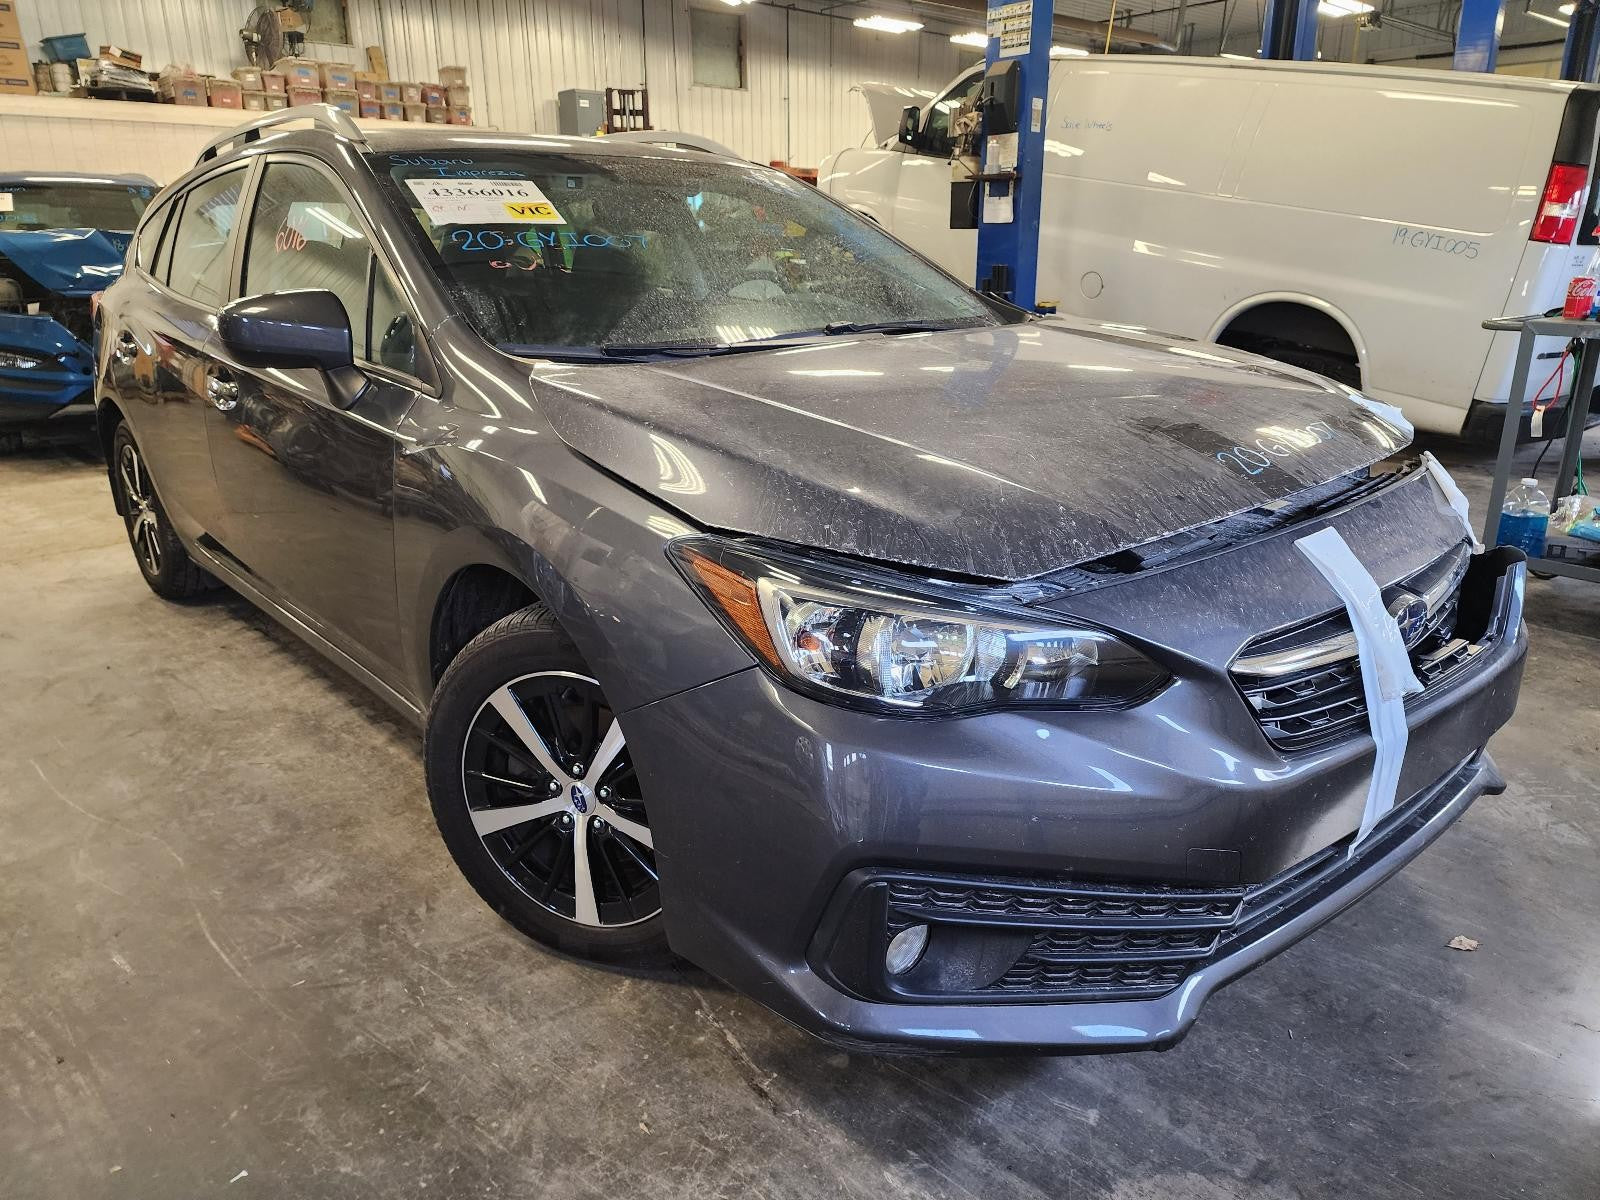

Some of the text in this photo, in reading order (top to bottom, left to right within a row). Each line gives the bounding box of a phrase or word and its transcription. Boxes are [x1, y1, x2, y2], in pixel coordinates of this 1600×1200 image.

[389, 154, 474, 167] Subaru
[429, 167, 526, 179] Impreza
[428, 187, 530, 198] 43366016
[510, 204, 552, 216] VIC
